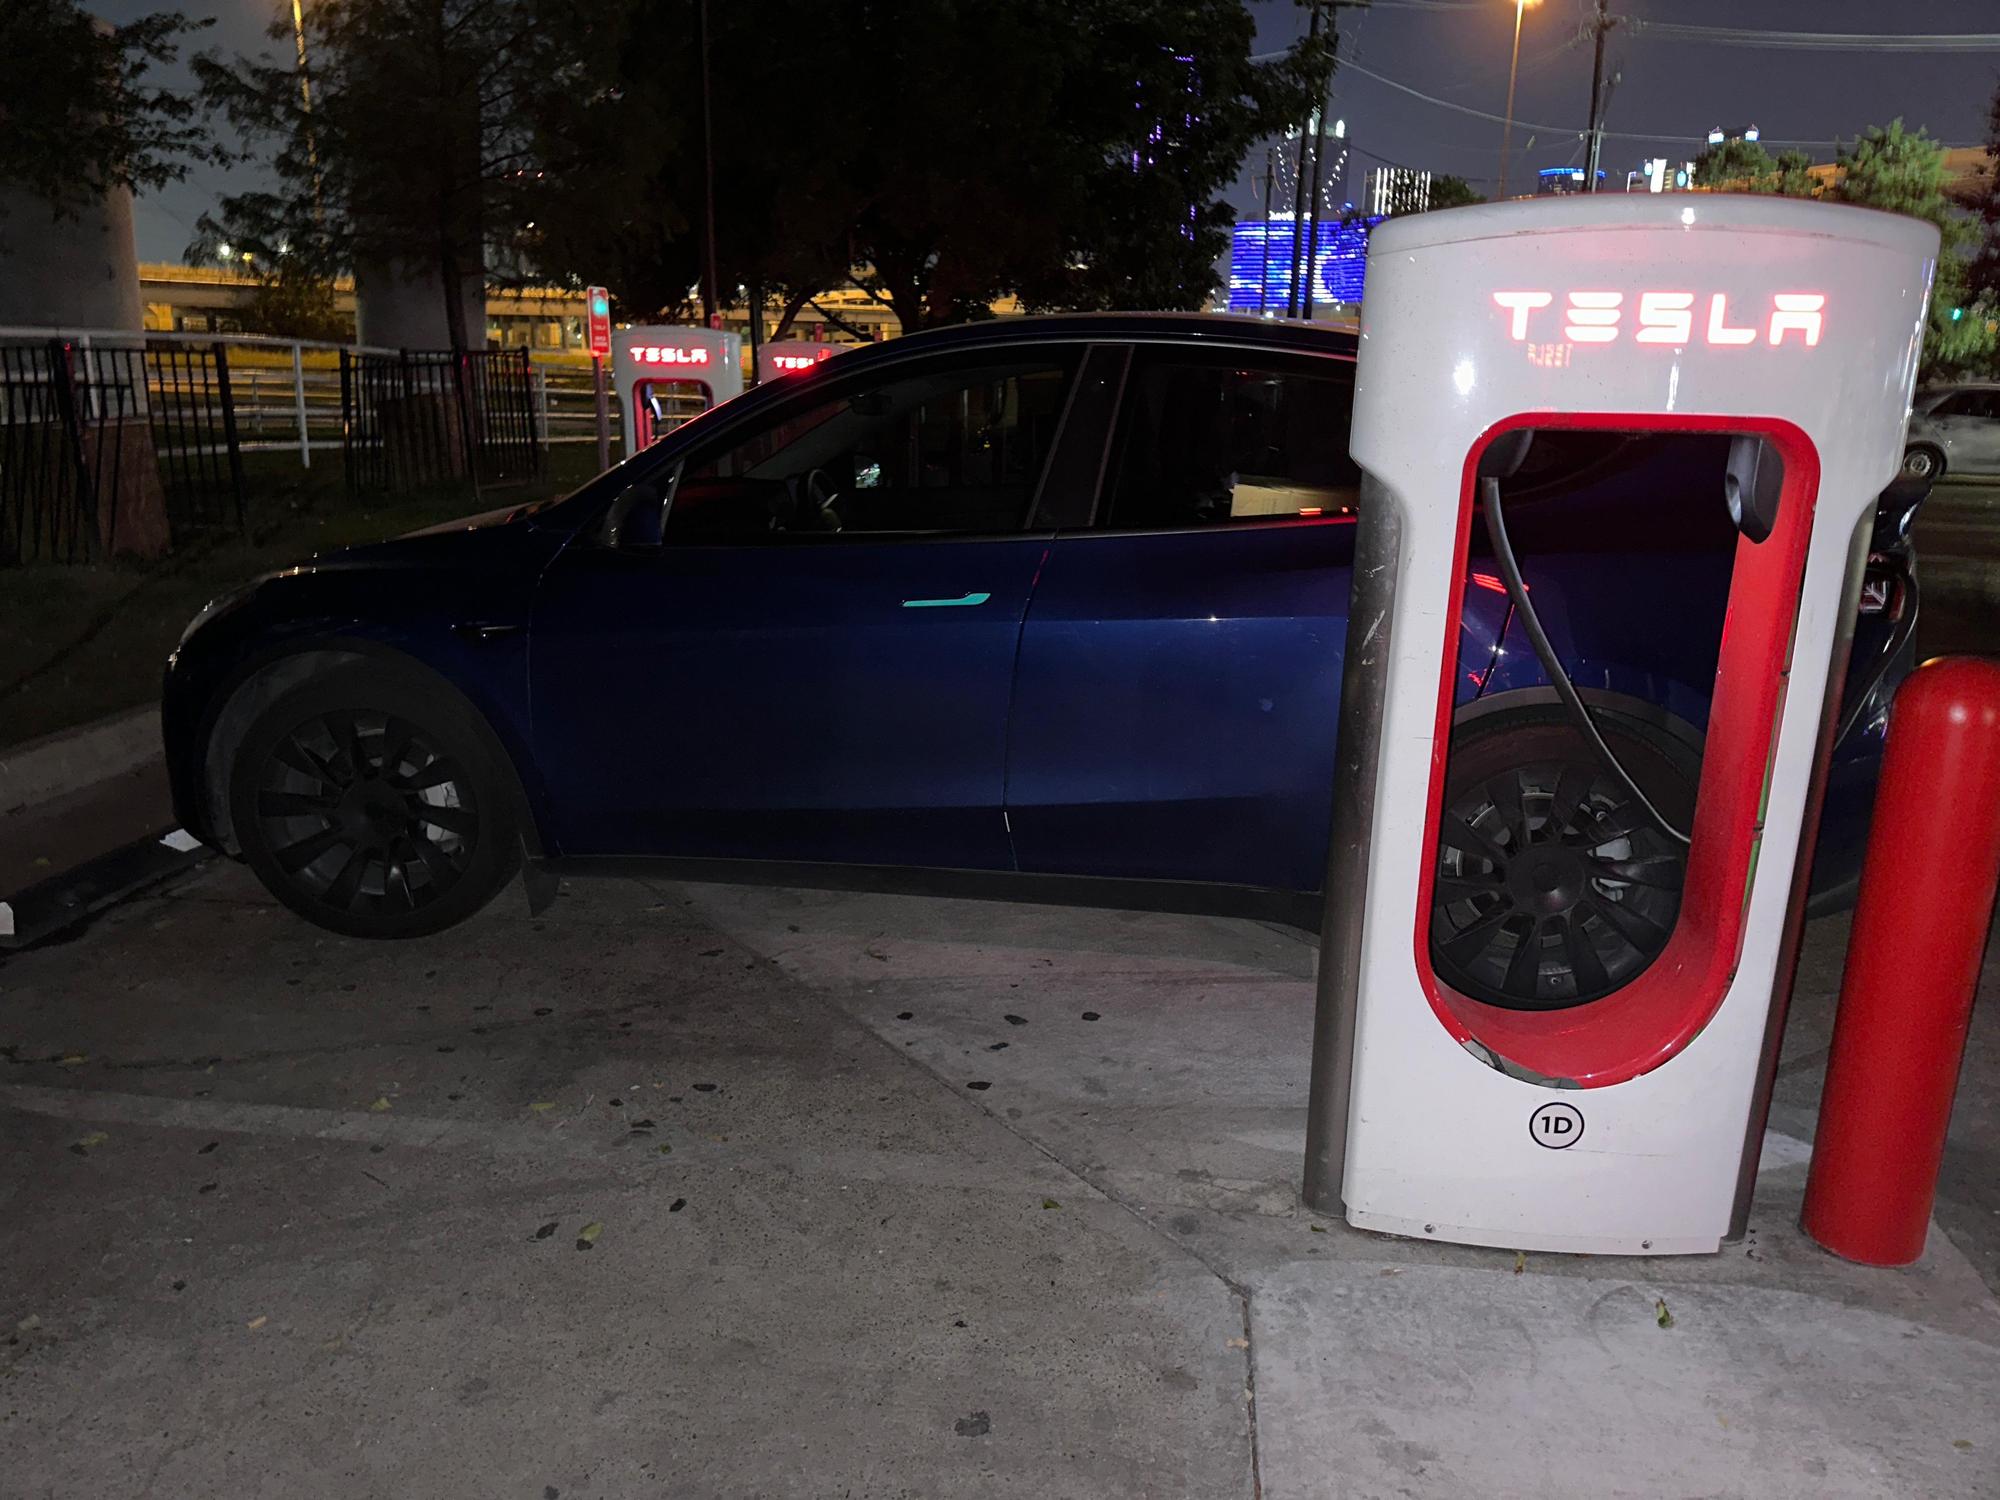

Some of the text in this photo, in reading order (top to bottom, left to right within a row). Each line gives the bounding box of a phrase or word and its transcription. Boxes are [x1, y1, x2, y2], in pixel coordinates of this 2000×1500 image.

[1493, 291, 1826, 346] TESLA
[629, 346, 708, 363] TESLA
[1541, 1115, 1573, 1134] 1D
